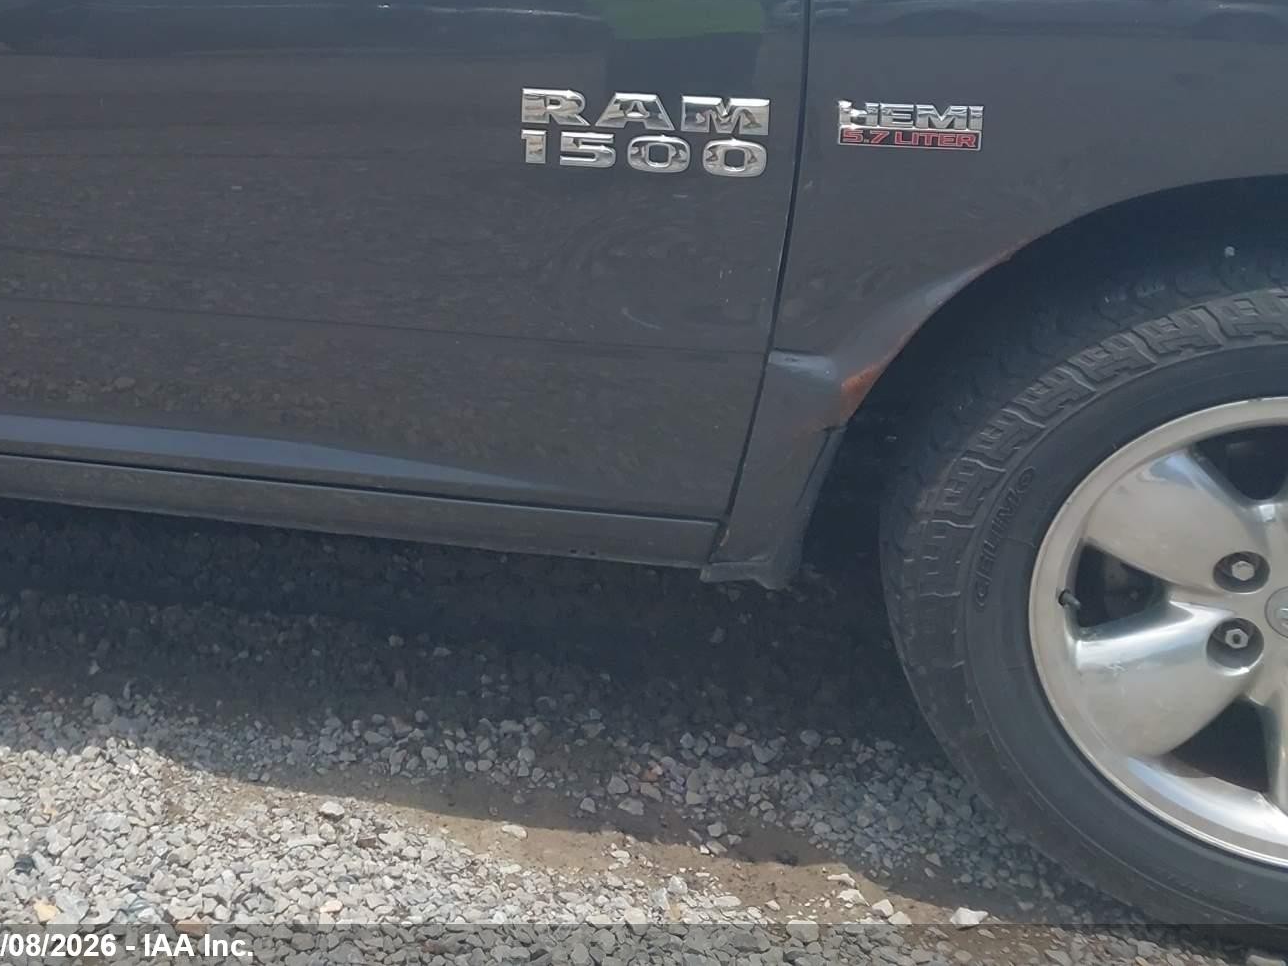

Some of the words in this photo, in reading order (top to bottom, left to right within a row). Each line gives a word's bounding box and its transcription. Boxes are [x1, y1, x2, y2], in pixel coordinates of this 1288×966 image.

[520, 87, 771, 135] RAM
[837, 99, 984, 131] HEMI
[520, 129, 768, 178] 1500
[841, 129, 890, 145] 5.7
[894, 130, 977, 148] LITER
